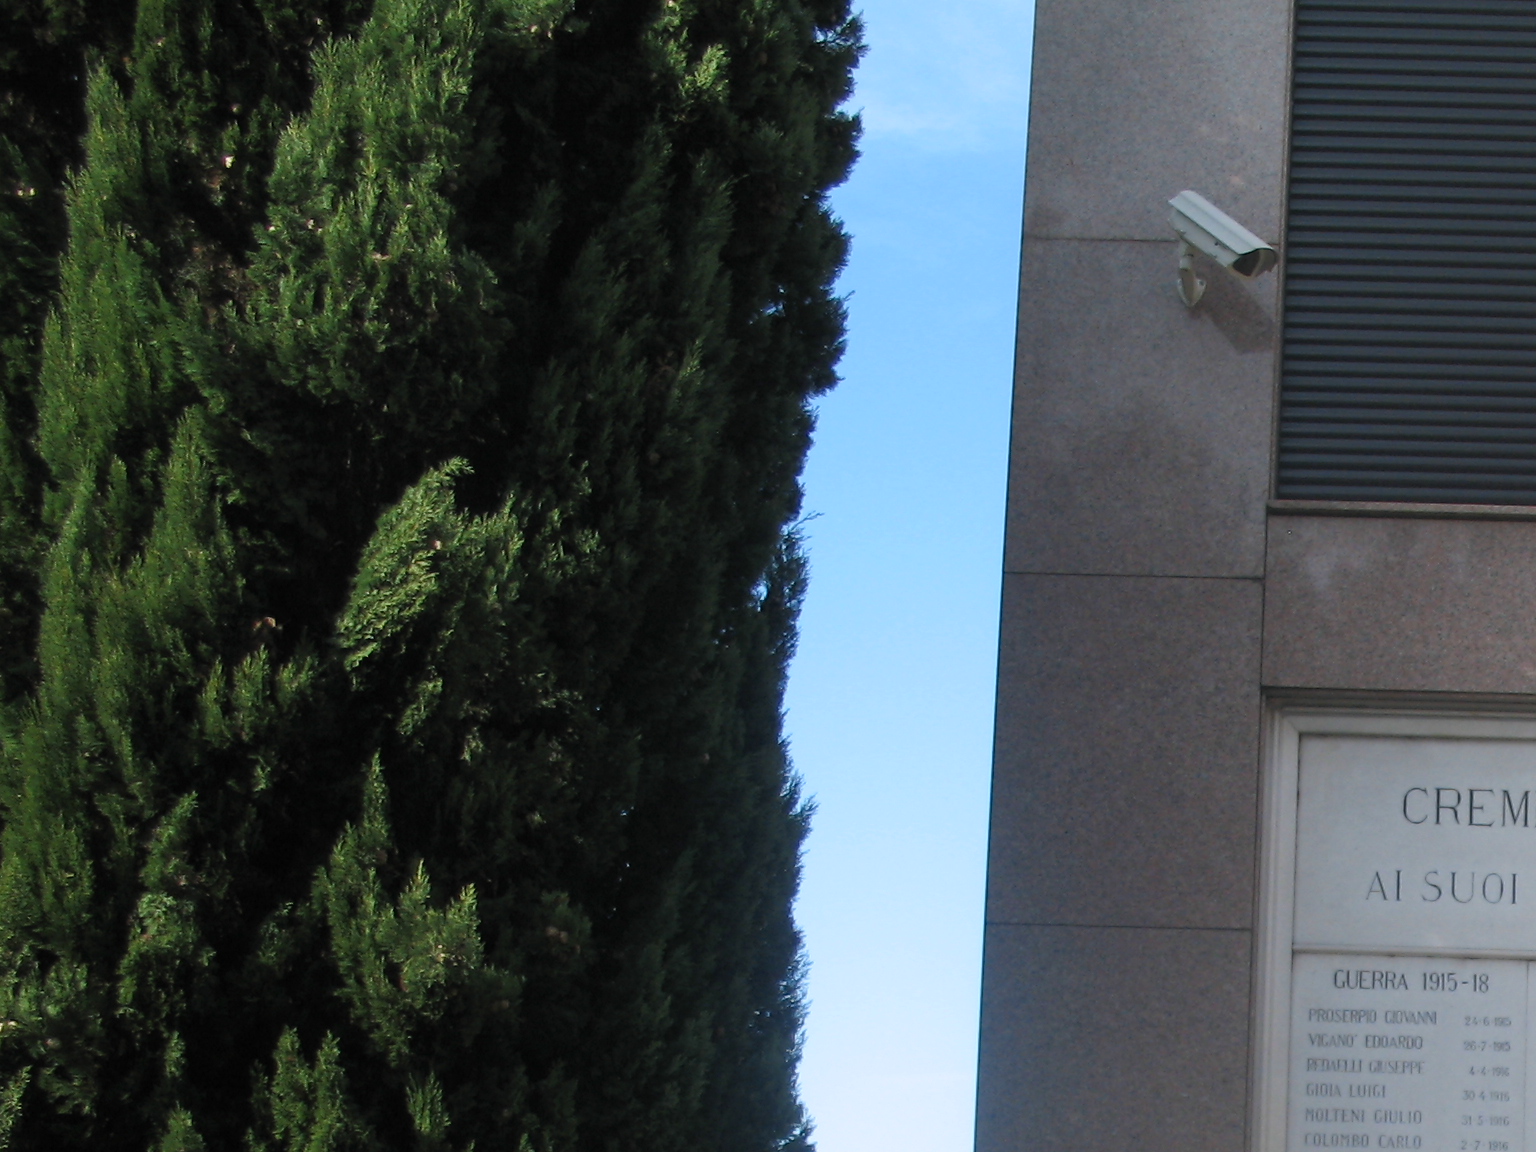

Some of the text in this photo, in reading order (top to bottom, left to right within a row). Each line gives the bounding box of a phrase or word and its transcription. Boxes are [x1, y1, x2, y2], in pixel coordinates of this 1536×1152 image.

[1365, 870, 1402, 902] AI
[1422, 871, 1518, 905] SUOI
[1334, 969, 1489, 993] GUERRA 1915-18
[1308, 1009, 1377, 1024] PROSERPIO
[1385, 1010, 1437, 1025] GIOVANNI
[1365, 1035, 1423, 1050] EDOARDO
[1307, 1058, 1362, 1073] REDAELLI
[1370, 1060, 1424, 1074] GIUSEPPE
[1306, 1083, 1341, 1097] GIOIA
[1350, 1084, 1386, 1098] LUIGI
[1305, 1108, 1365, 1123] MOLTENI
[1374, 1110, 1422, 1124] GIULIO
[1304, 1133, 1369, 1147] COLOMBO
[1378, 1135, 1422, 1149] CARLO
